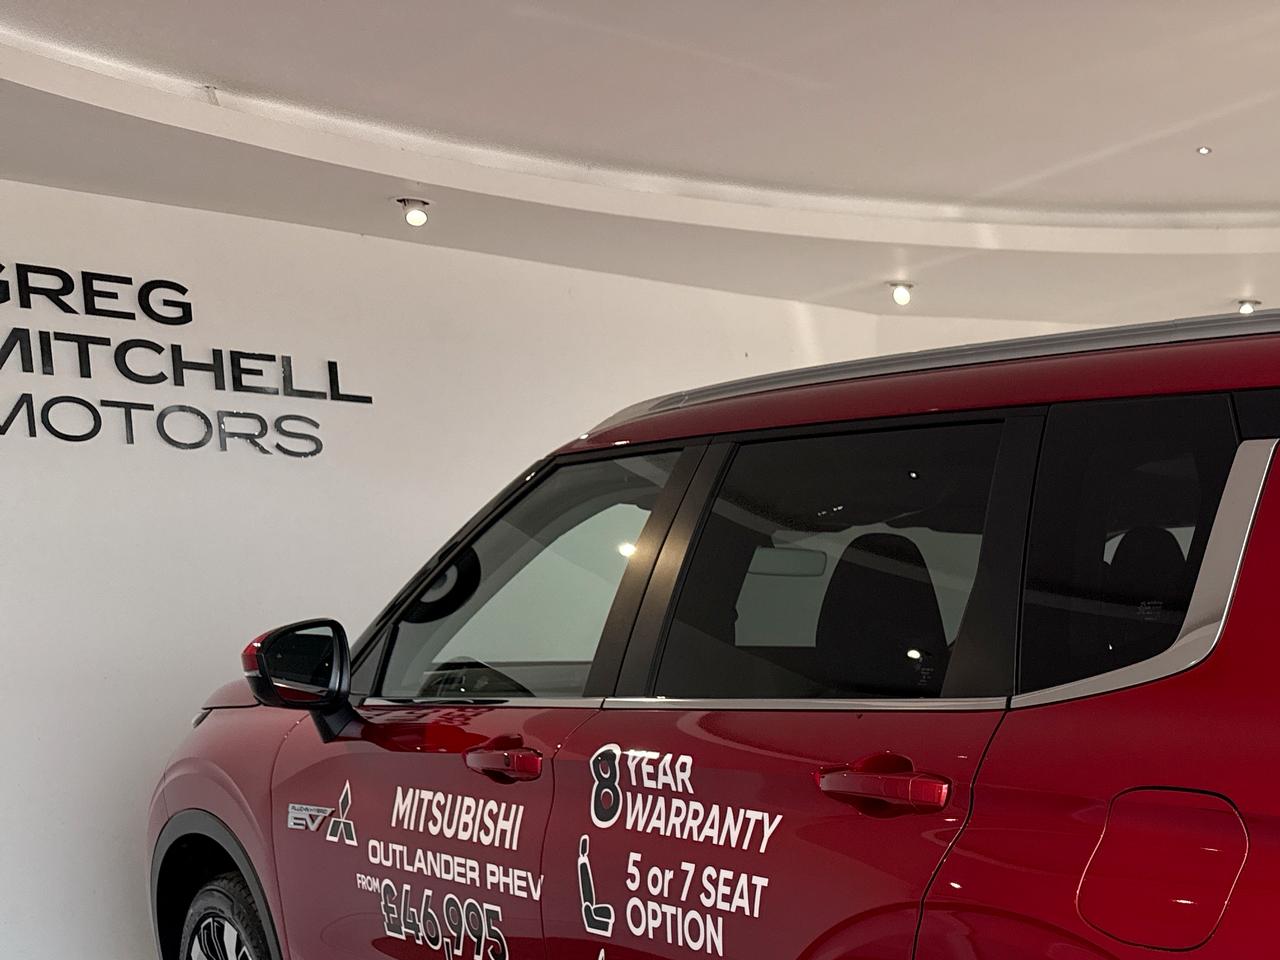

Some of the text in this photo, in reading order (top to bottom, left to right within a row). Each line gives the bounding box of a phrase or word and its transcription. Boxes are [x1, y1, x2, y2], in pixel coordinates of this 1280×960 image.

[0, 263, 193, 326] REG
[590, 743, 694, 828] 8 YEAR
[288, 812, 328, 832] EV
[391, 786, 525, 850] MITSUBISHI
[625, 791, 783, 853] WARRANTY
[356, 873, 380, 894] FROM
[367, 839, 545, 901] OUTLANDER PHEV
[625, 852, 769, 918] 5 or 7 SEAT
[626, 897, 723, 957] OPTION
